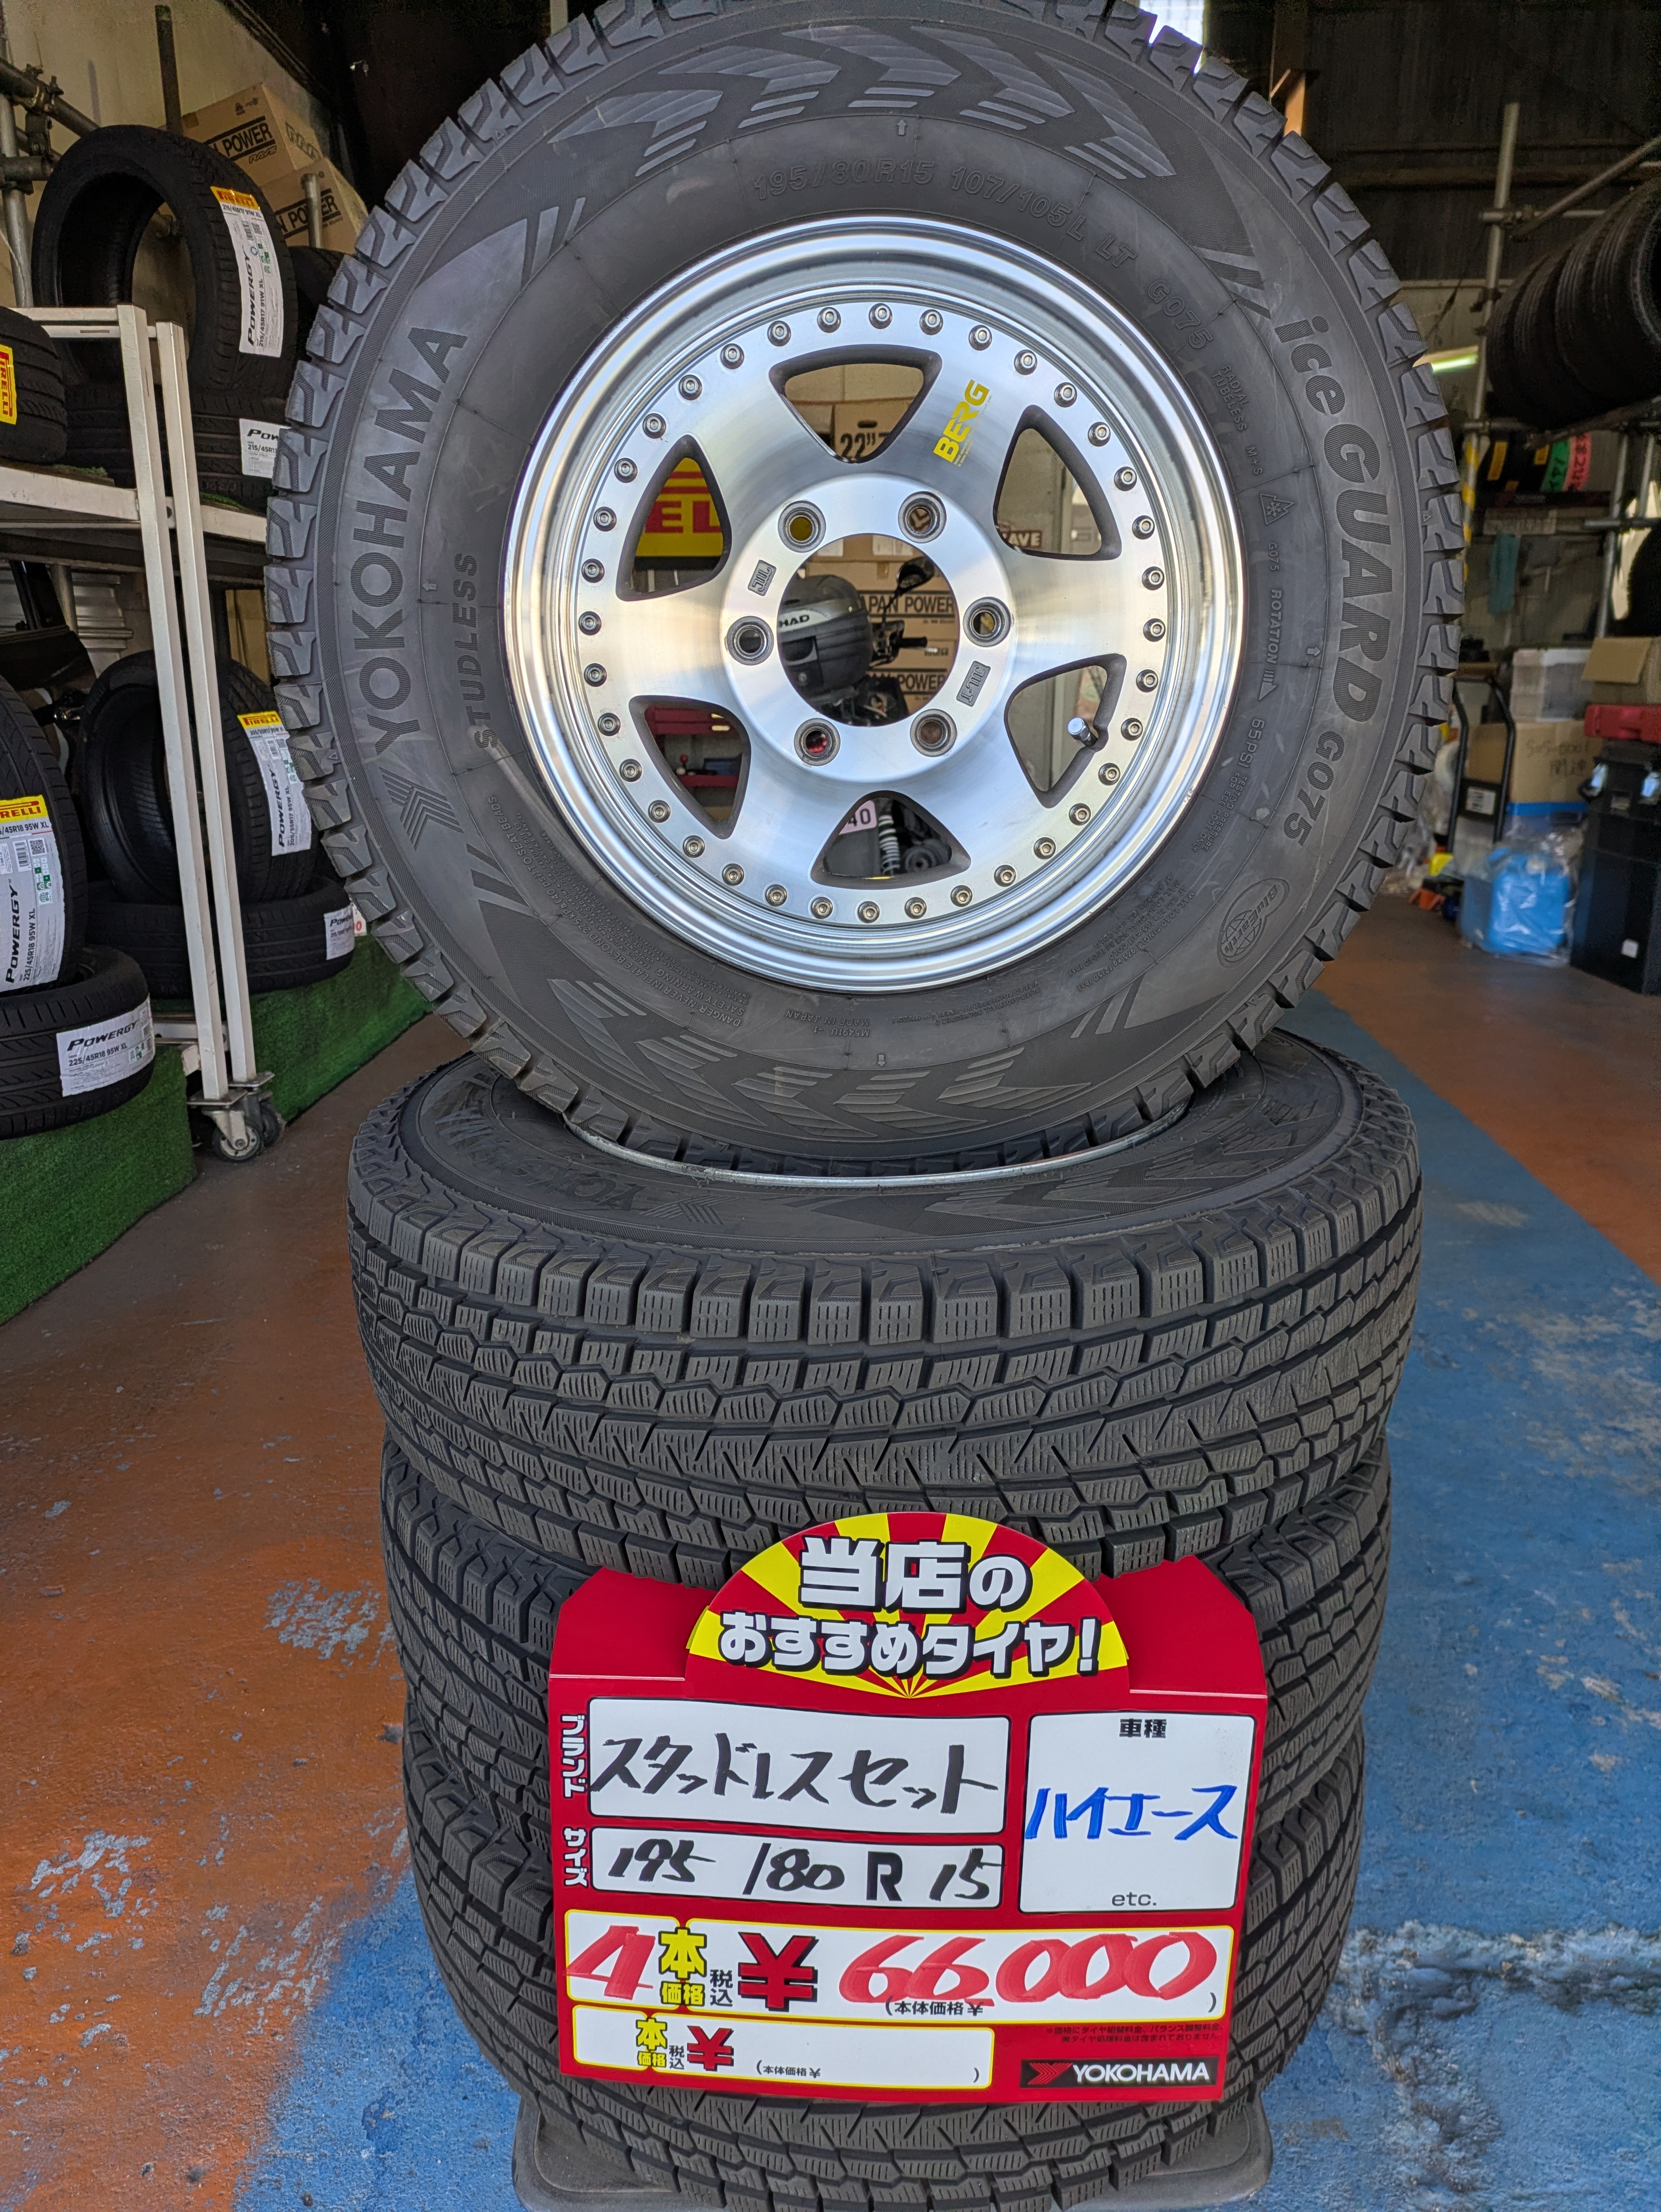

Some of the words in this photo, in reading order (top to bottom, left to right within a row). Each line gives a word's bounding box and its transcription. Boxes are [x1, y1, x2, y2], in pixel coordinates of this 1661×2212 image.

[221, 120, 273, 156] POWER
[288, 195, 339, 229] POER
[751, 156, 936, 201] 195/80R15
[947, 163, 1094, 243] 107/105L
[1093, 231, 1138, 274] LT
[242, 244, 255, 346] POWERGY
[258, 278, 265, 289] XL
[1219, 363, 1251, 409] RADIAL
[1209, 370, 1249, 432] TUBELESS
[933, 379, 990, 463] BERG
[1244, 444, 1264, 476] M+S
[351, 327, 468, 754] YOKOHAMA
[1001, 531, 1041, 547] AVE
[905, 596, 955, 614] POWER
[1265, 588, 1282, 664] ROTATION
[451, 551, 501, 755] STUDLESS
[1246, 717, 1266, 742] 65
[1236, 740, 1258, 770] PSI
[1227, 770, 1240, 789] FOR
[1218, 789, 1231, 807] ECE
[1225, 774, 1248, 811] TESTING
[268, 764, 285, 848] POWERGY
[24, 822, 39, 832] 95W
[40, 821, 50, 829] XL
[514, 810, 533, 838] MANUAL
[1200, 810, 1230, 852] PRESSURE
[1204, 807, 1222, 831] CODE
[505, 829, 527, 858] SEAT
[519, 830, 530, 845] DUE
[1190, 830, 1207, 852] ONLY
[521, 854, 537, 872] TO
[527, 843, 547, 870] FAILURE
[553, 849, 571, 871] MOUNT
[544, 868, 558, 884] TIRE
[548, 863, 569, 887] FOLLOW
[556, 863, 568, 877] DUE
[569, 870, 589, 893] SHOULD
[565, 875, 592, 905] ASSEMBLY
[28, 908, 36, 919] XL
[557, 900, 577, 921] kPa
[575, 904, 596, 926] RESULT
[587, 890, 613, 916] PERSONS
[572, 916, 592, 936] 275
[594, 922, 607, 936] MAY
[610, 913, 636, 936] TRAINED
[1159, 907, 1179, 928] LOAD
[1224, 884, 1278, 954] BluEarth
[5, 884, 20, 984] POWERGY
[605, 933, 627, 953] INJURY
[623, 932, 656, 959] EXPLOSION
[634, 933, 664, 957] SPECIALLY
[1134, 924, 1162, 951] SINGLE
[587, 930, 626, 965] BEYOND
[625, 949, 651, 971] SERIOUS
[1121, 947, 1136, 961] 975
[23, 942, 35, 981] 225/45R18
[623, 959, 664, 991] INFLATE
[652, 965, 704, 1000] WARNING:
[694, 978, 723, 995] PLACARD
[662, 984, 698, 1009] NEVER
[717, 983, 750, 999] IMPROPER
[722, 991, 738, 1001] TIRE
[704, 993, 745, 1017] SAFETY
[785, 1008, 821, 1024] JAPAN
[823, 1015, 836, 1025] IN
[830, 1026, 869, 1038] M5491U
[838, 1016, 869, 1027] MADE
[66, 1021, 137, 1051] POWERGY
[68, 1051, 106, 1067] 225/45R18
[106, 1045, 120, 1056] 95W
[799, 1537, 1029, 1609] 当店の
[1119, 1718, 1167, 1738] 車種
[561, 1714, 587, 1799] ブランド
[590, 1732, 999, 1814] スタッドレスセット
[1024, 1784, 1239, 1841] ハイエース
[563, 1827, 588, 1887] サイズ
[608, 1838, 717, 1883] 195
[866, 1851, 903, 1902] R
[928, 1847, 1006, 1902] 15
[1111, 1891, 1157, 1907] etc.
[563, 1925, 656, 2000] 4
[658, 1928, 707, 1980] 本
[660, 1982, 706, 2007] 価格
[709, 1969, 733, 2007] 税込
[636, 2017, 667, 2051] 本
[637, 2051, 667, 2068] 価格
[669, 2045, 686, 2069] 税込
[1073, 2062, 1211, 2085] YOKOHAMA
